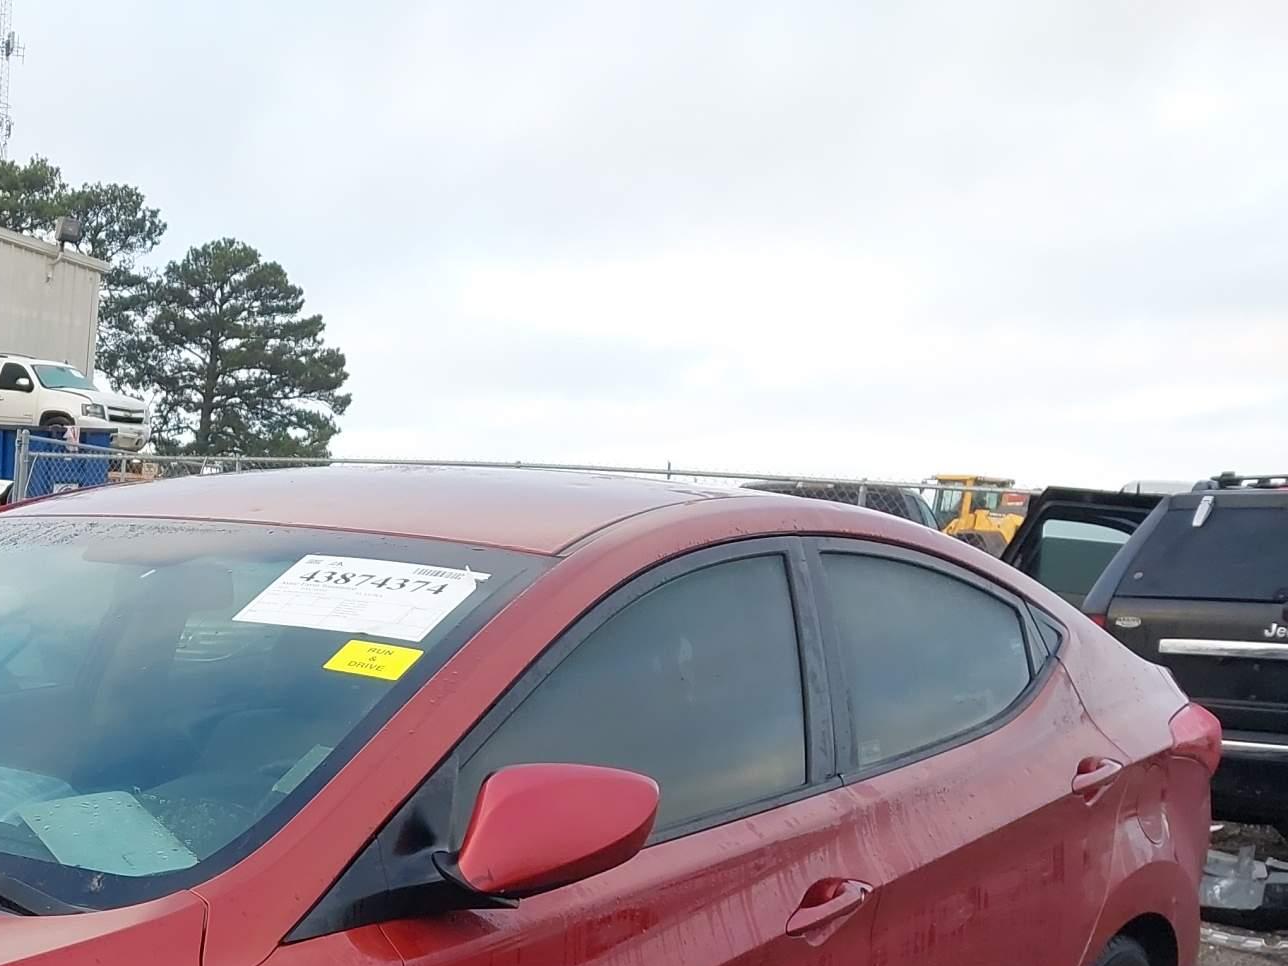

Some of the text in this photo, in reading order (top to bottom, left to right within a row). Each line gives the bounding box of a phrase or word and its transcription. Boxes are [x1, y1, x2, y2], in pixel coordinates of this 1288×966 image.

[299, 569, 449, 595] 43874374
[1264, 623, 1288, 638] Je
[367, 647, 394, 656] RUN
[347, 660, 385, 672] DRIVE
